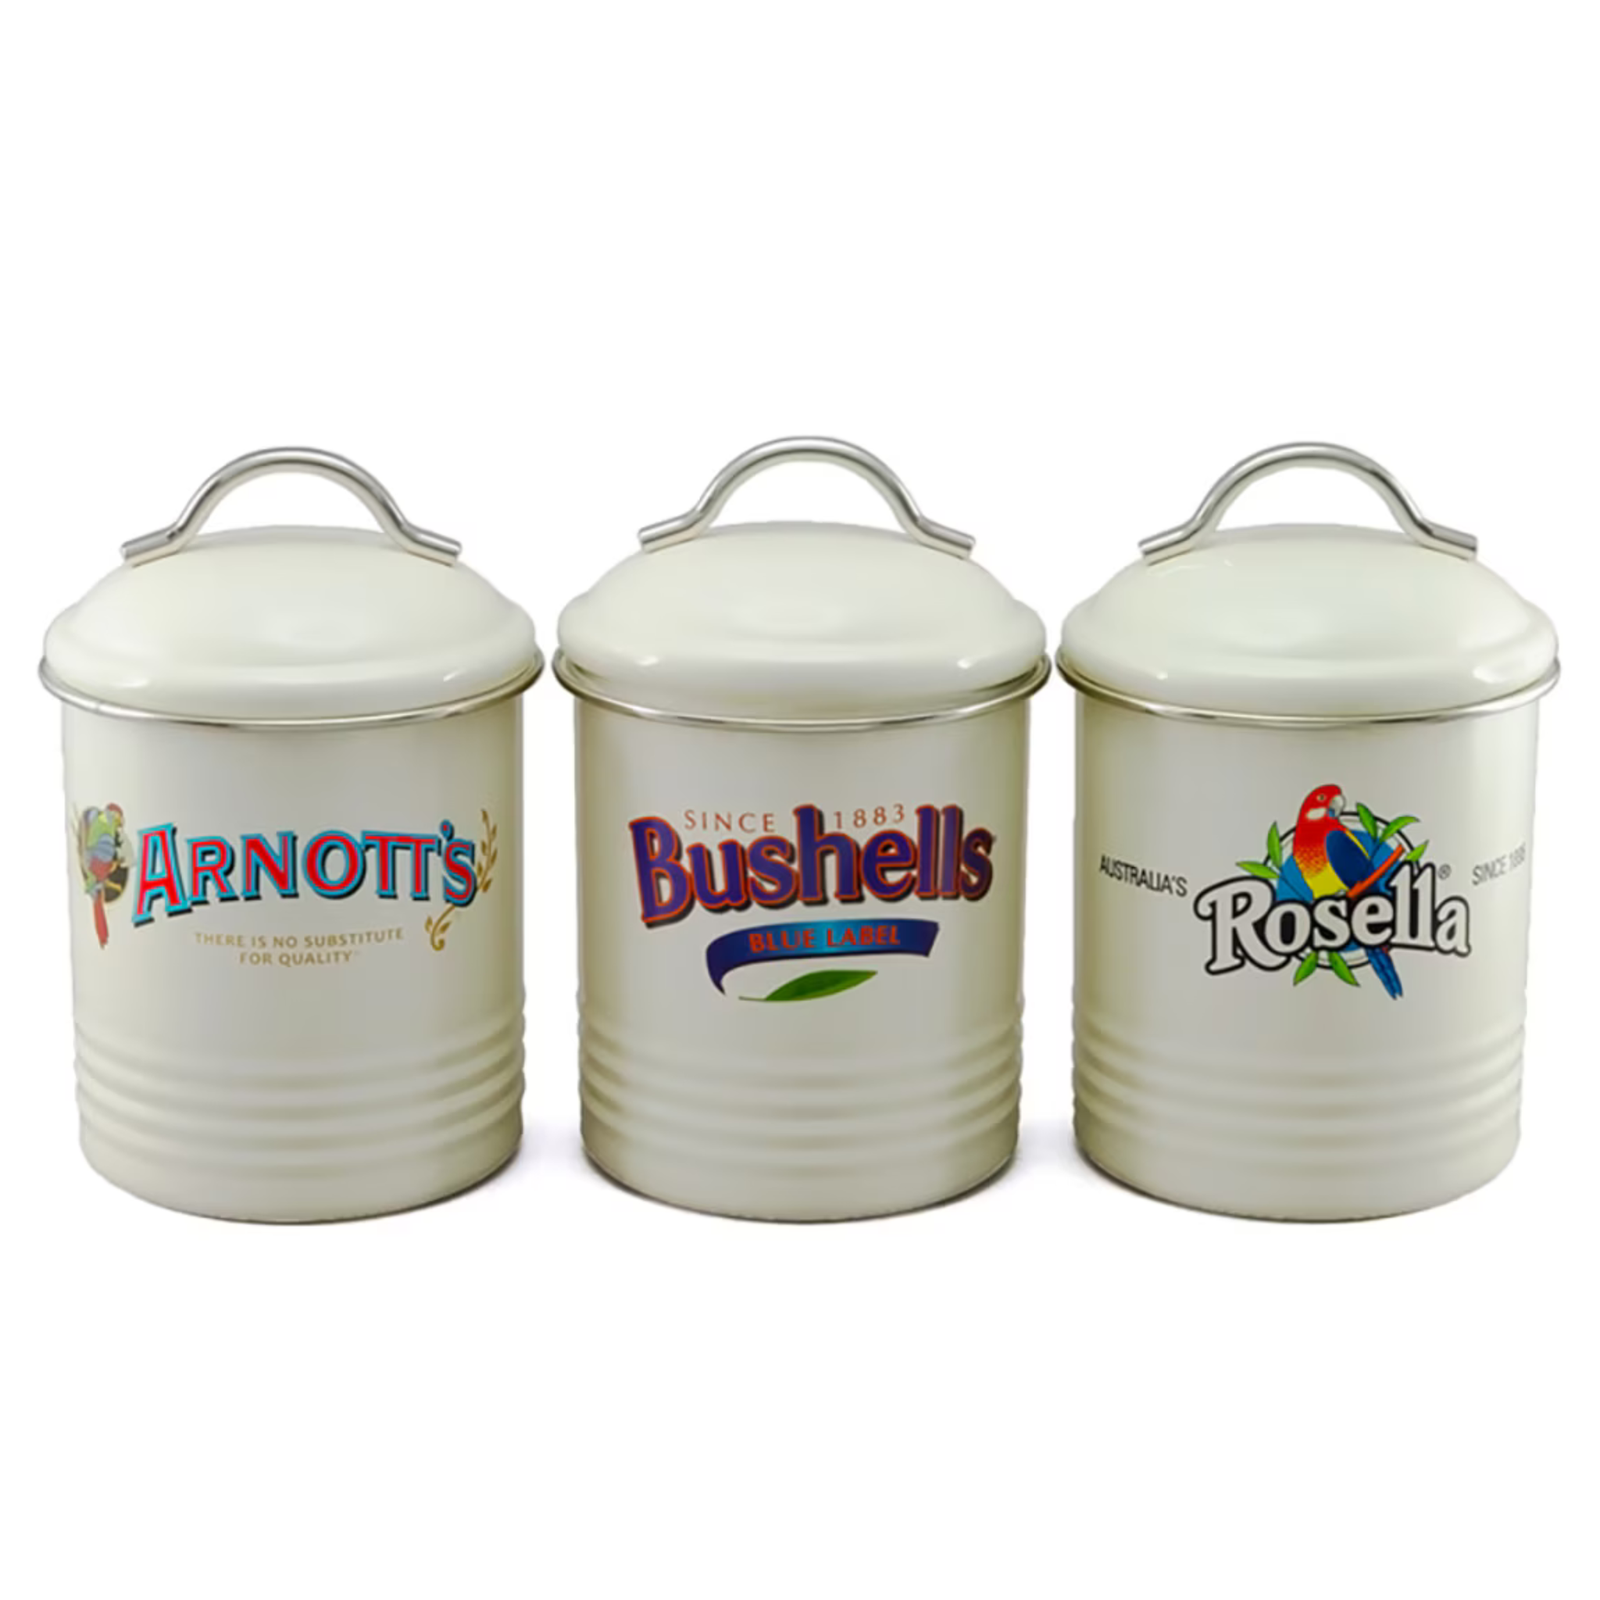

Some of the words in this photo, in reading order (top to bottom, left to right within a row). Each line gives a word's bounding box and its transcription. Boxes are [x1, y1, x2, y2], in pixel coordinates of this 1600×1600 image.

[684, 809, 776, 833] SINCE
[833, 803, 905, 829] 1883
[132, 820, 478, 927] ARNOTT'S
[629, 804, 994, 929] Bushells
[1099, 854, 1188, 898] AUSTRALIA'S
[1471, 853, 1507, 886] SINCE
[1193, 860, 1471, 975] Rosella
[194, 931, 245, 948] THERE
[251, 935, 267, 949] IS
[272, 935, 299, 949] NO
[304, 926, 405, 949] SUBSTITUTE
[748, 928, 816, 954] BLUE
[826, 924, 902, 948] LABEL
[239, 951, 273, 966] FOR
[278, 949, 353, 967] QUALITY
